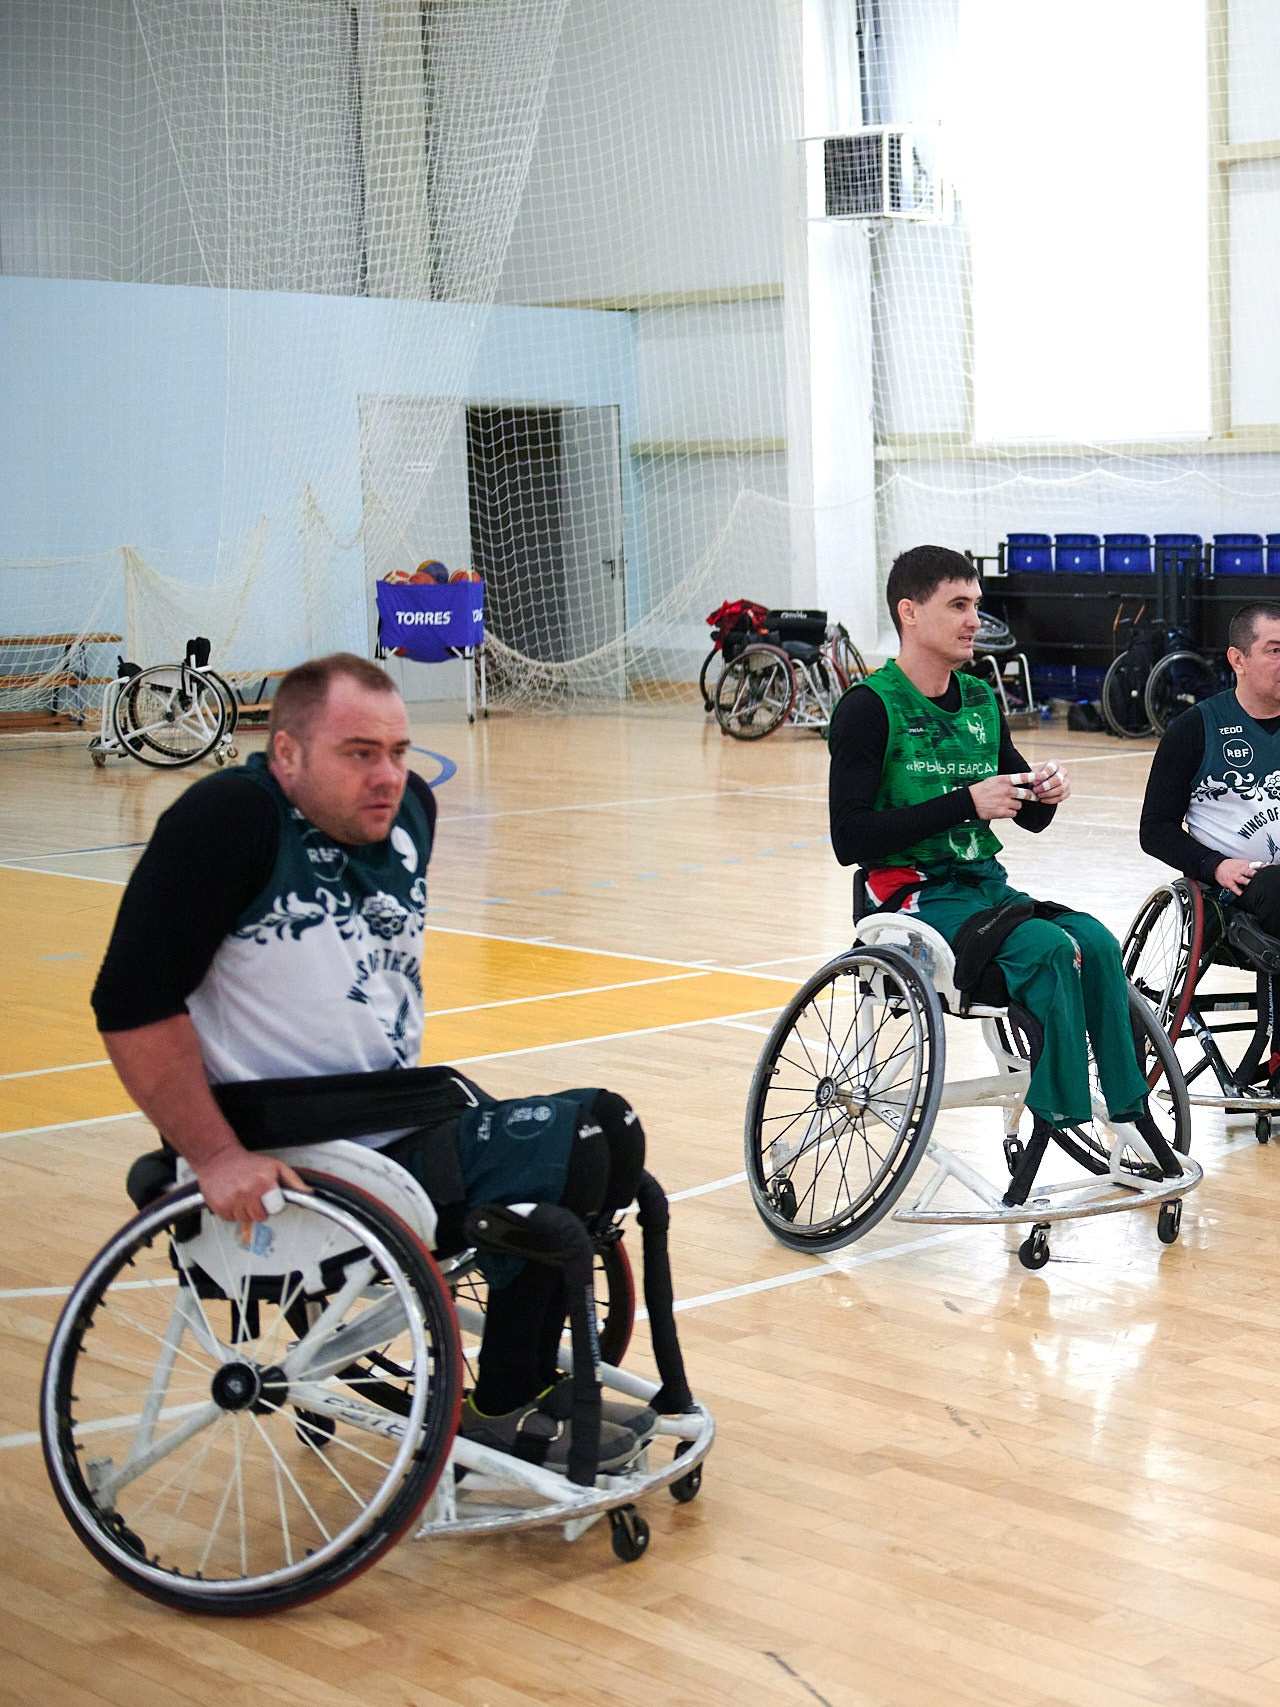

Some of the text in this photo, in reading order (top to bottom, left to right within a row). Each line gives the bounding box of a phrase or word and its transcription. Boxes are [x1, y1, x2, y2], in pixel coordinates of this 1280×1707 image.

[395, 611, 452, 625] TORRES
[1227, 748, 1249, 758] RBF
[906, 760, 955, 775] «КРЫЬЯ
[1237, 811, 1268, 840] WINGS
[1266, 806, 1280, 822] OF
